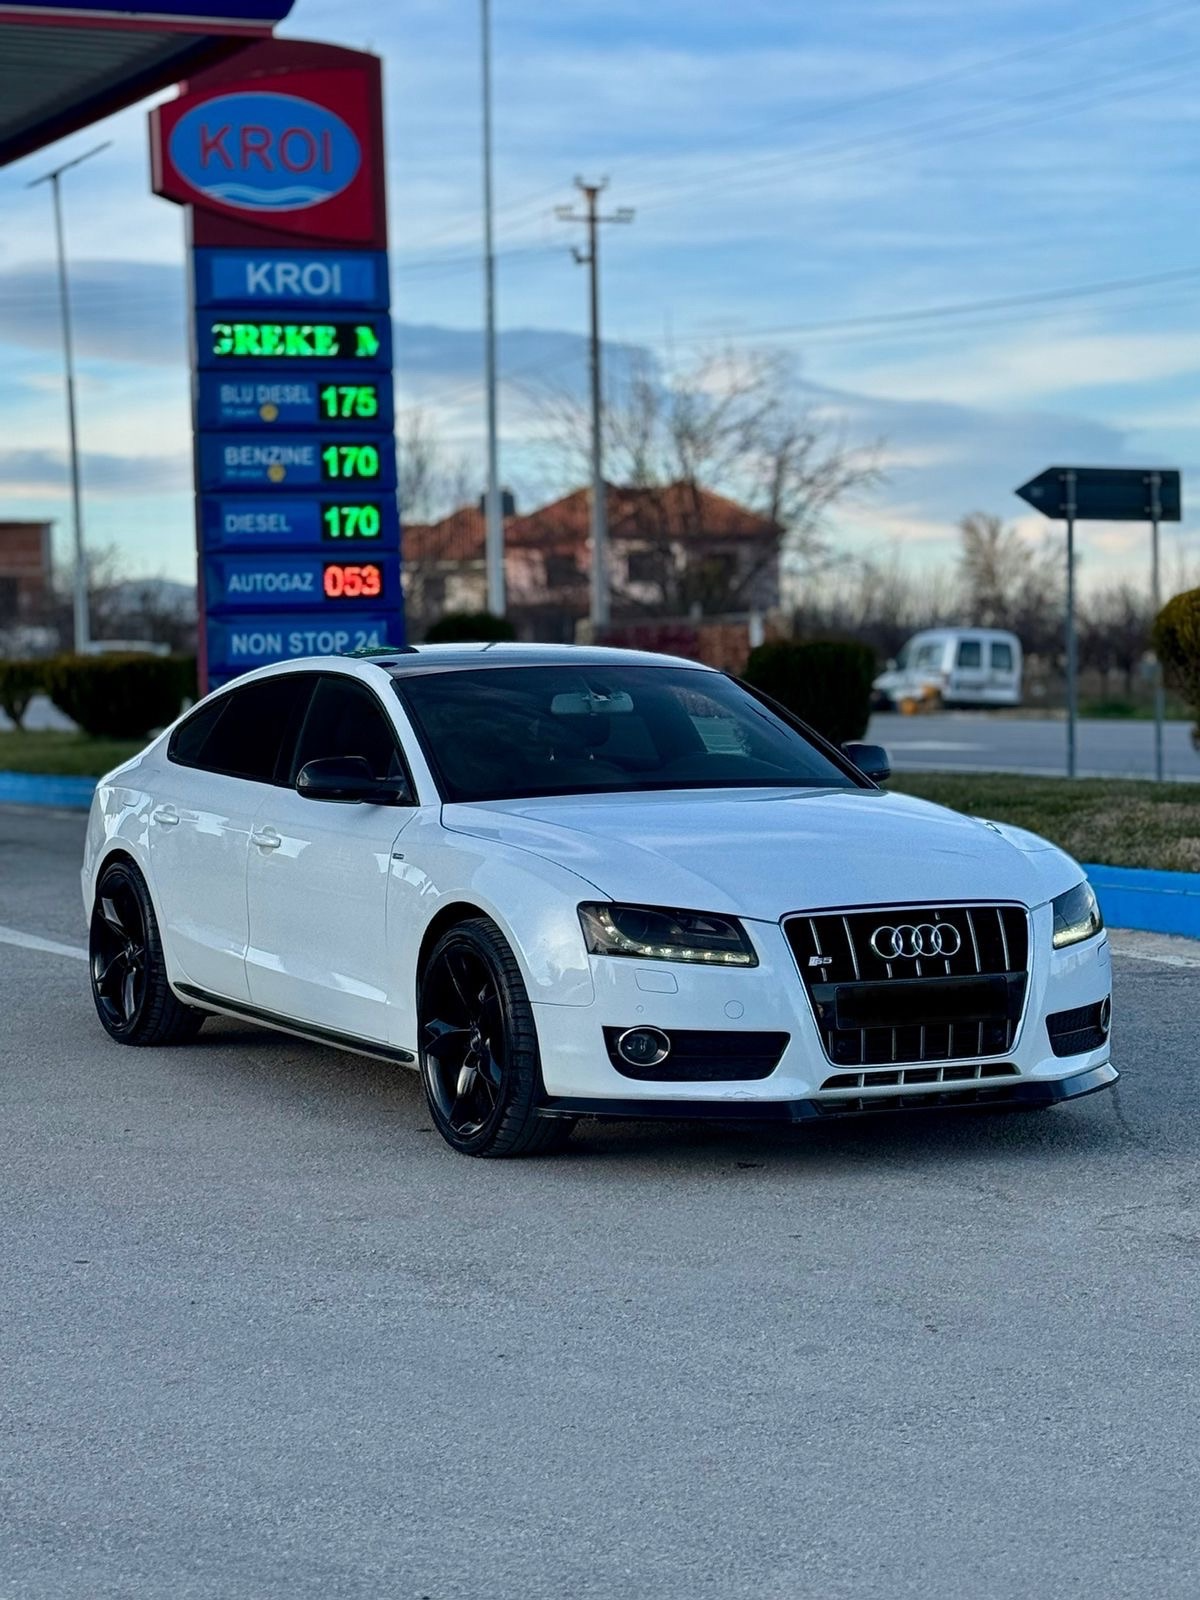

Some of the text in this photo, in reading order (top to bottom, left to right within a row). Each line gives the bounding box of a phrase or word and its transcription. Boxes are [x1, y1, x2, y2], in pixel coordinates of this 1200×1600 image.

[200, 123, 331, 174] KROI
[246, 261, 341, 296] KROI
[220, 384, 313, 405] BLU DIESEL
[321, 385, 378, 417] 175
[224, 446, 314, 466] BENZINE
[323, 445, 379, 478] 170
[225, 513, 291, 533] DIESEL
[324, 505, 380, 537] 170
[228, 572, 314, 592] AUTOGAZ
[323, 564, 381, 597] 053
[231, 630, 380, 655] NON STOP 24
